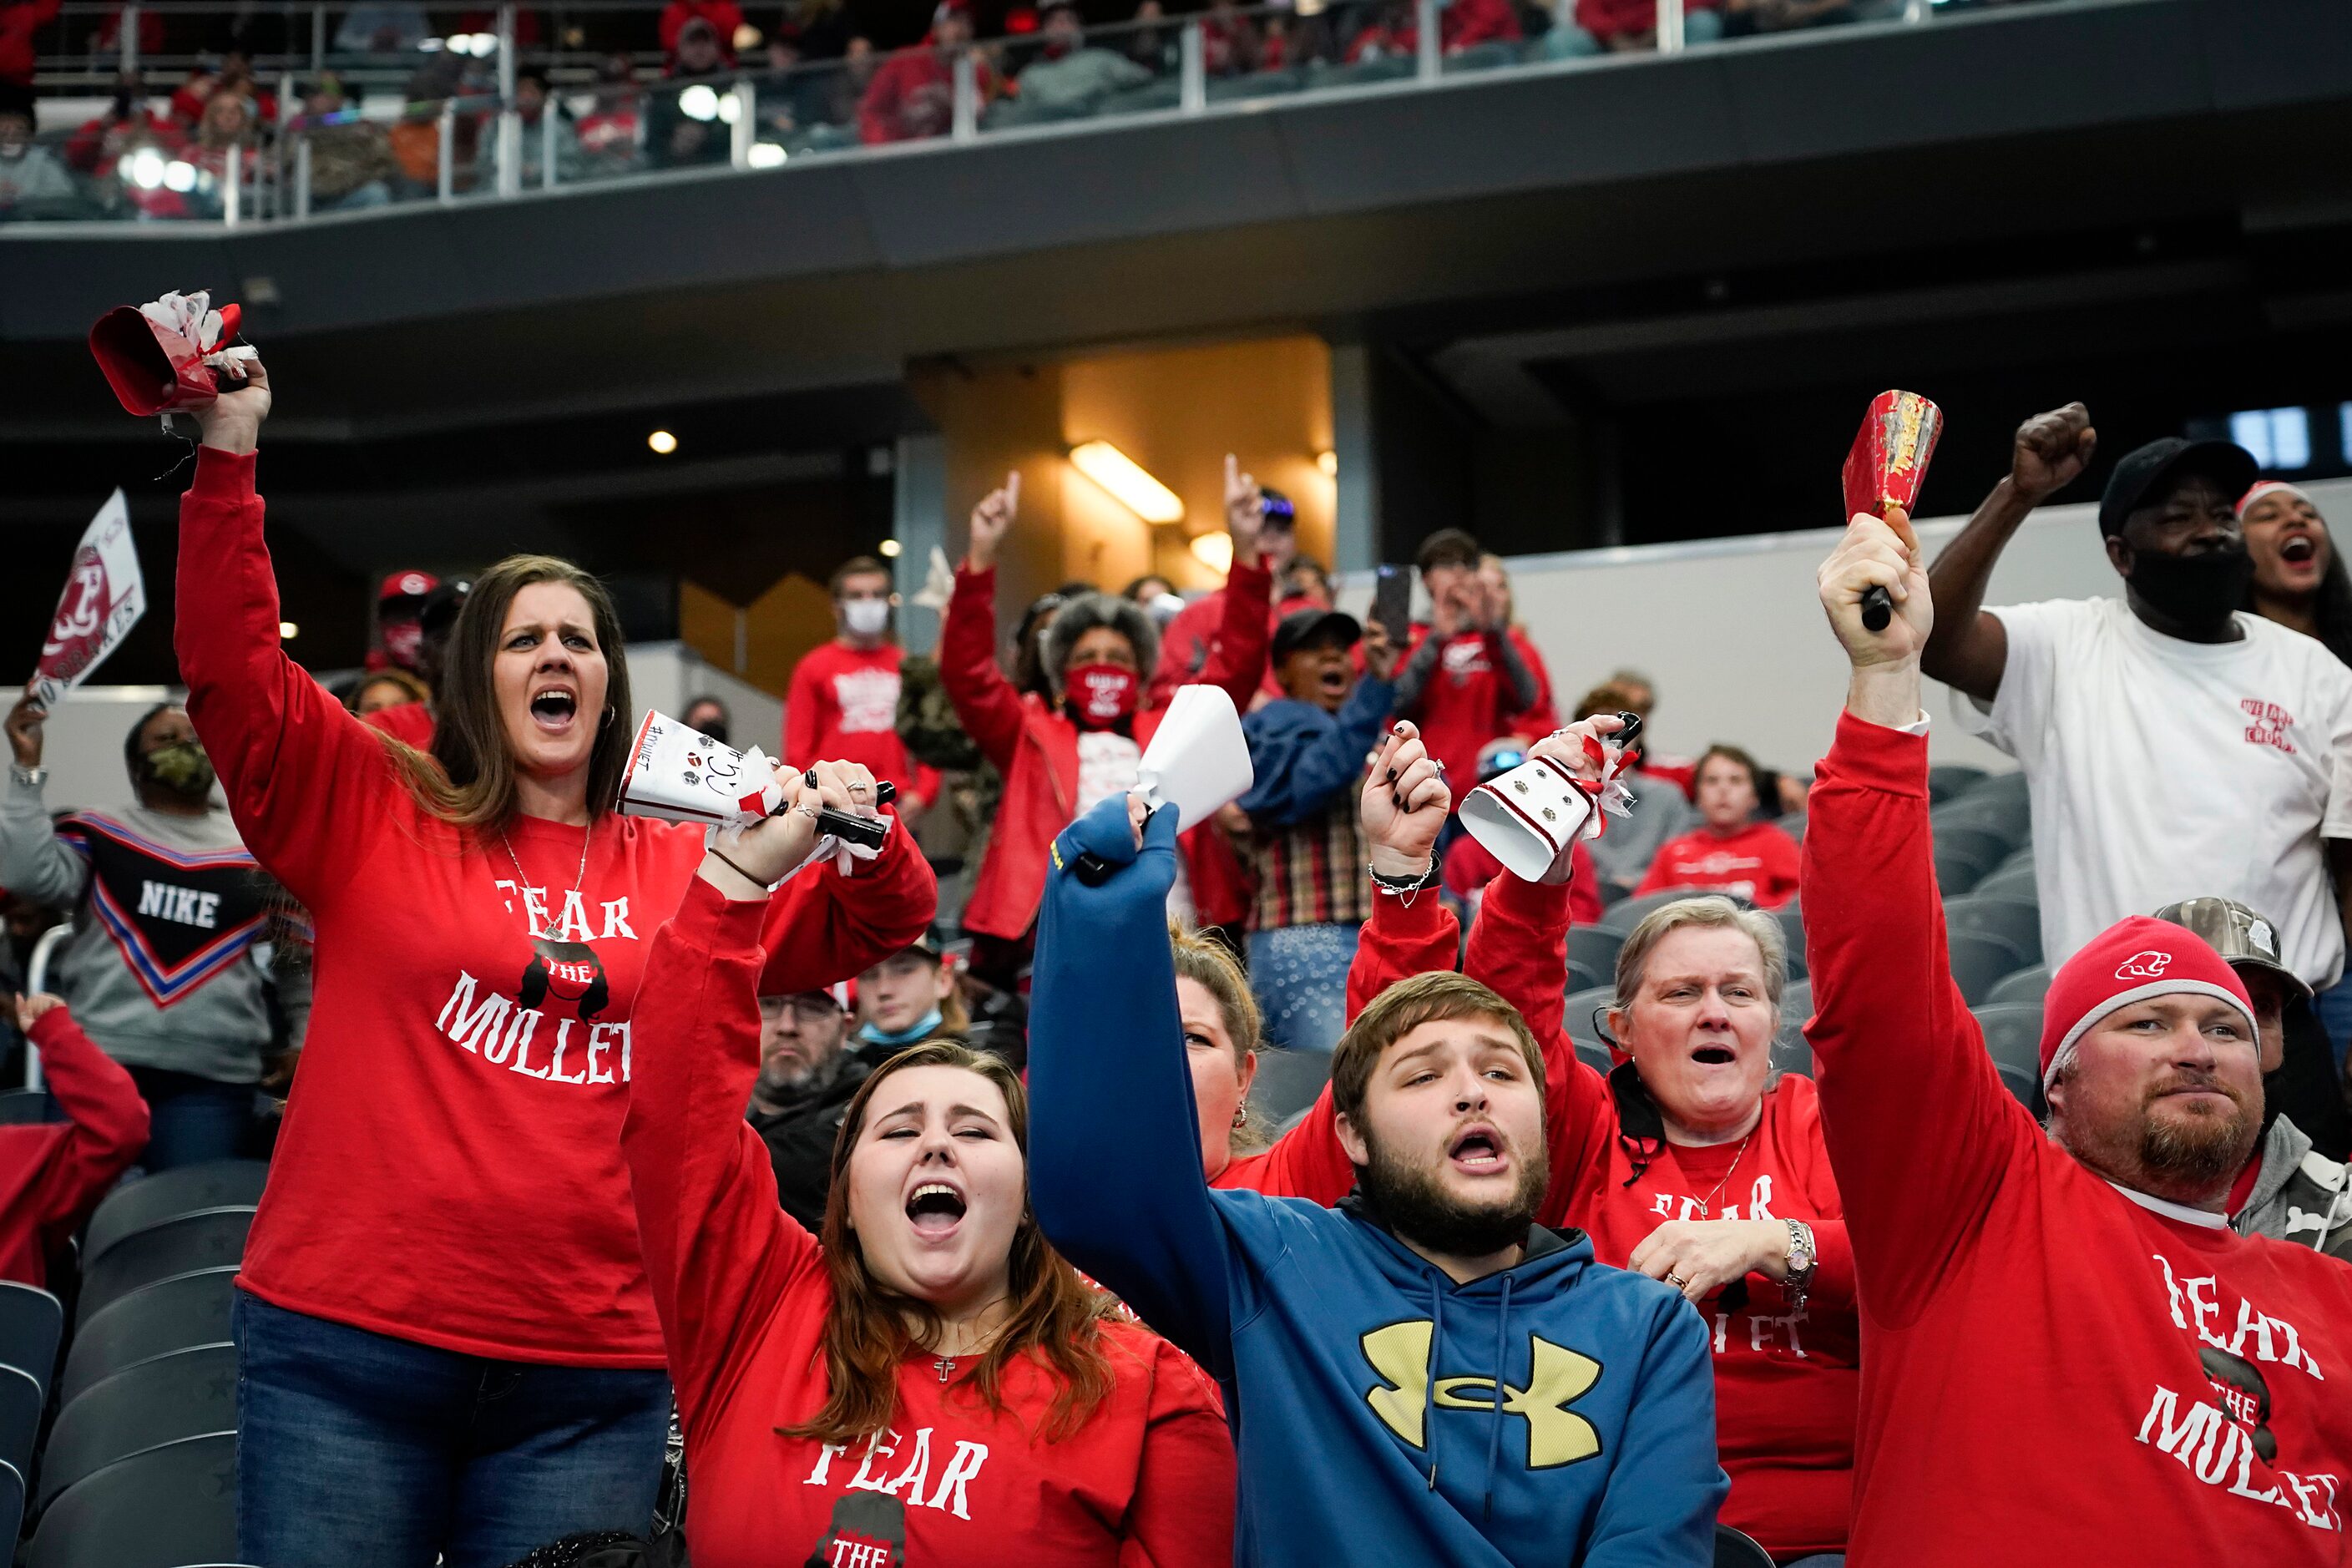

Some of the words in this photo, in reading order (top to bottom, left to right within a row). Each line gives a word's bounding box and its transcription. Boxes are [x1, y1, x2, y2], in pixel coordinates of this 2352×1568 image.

[137, 879, 221, 928] NIKE
[544, 956, 593, 984] THE
[434, 969, 631, 1085] MULLET
[802, 1426, 989, 1521] FEAR
[831, 1539, 888, 1568] THE
